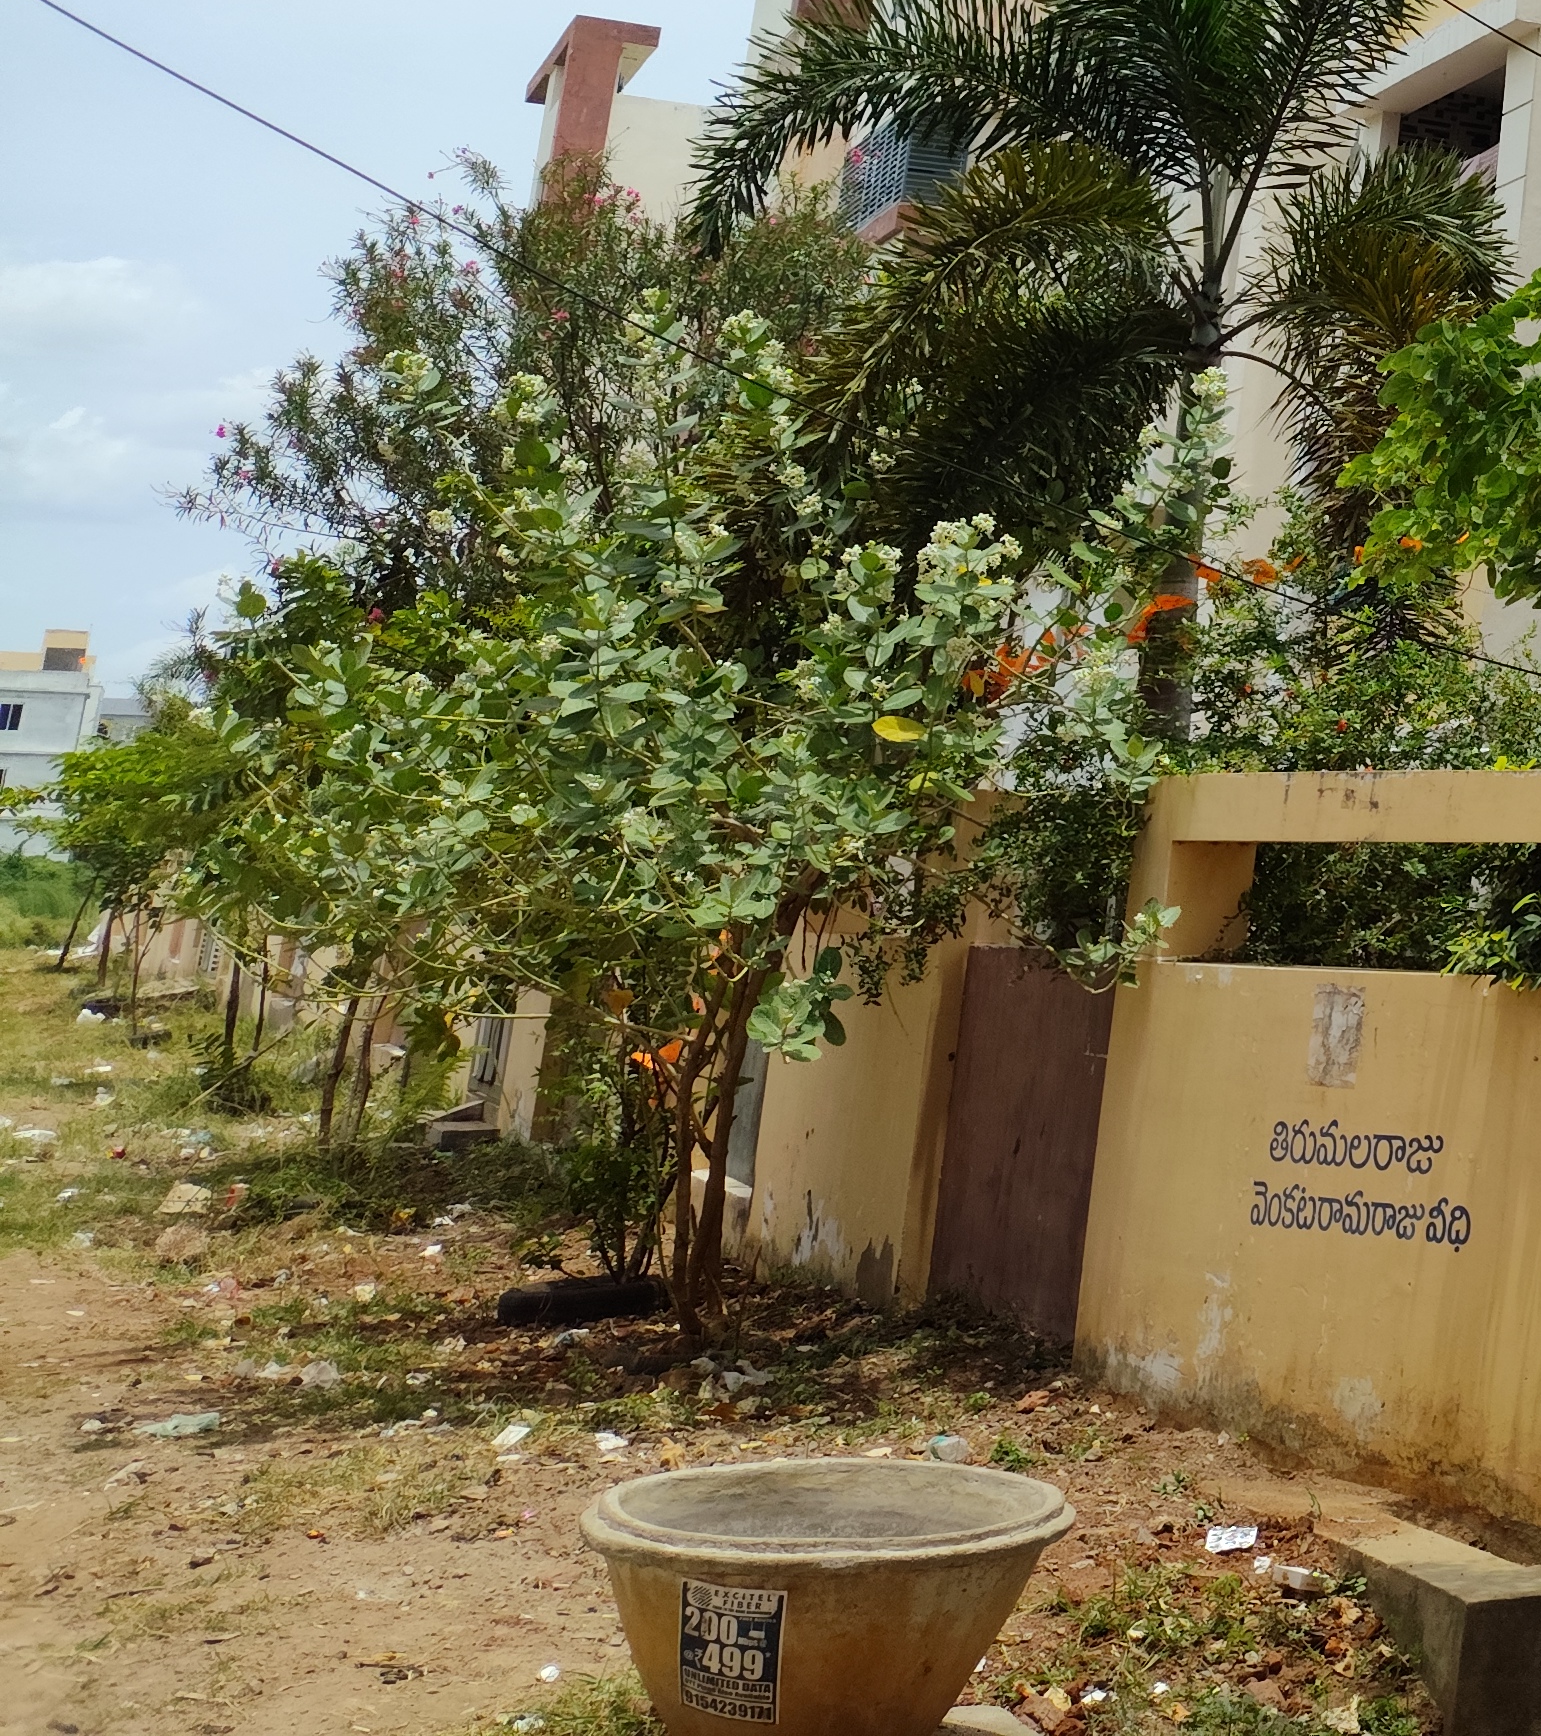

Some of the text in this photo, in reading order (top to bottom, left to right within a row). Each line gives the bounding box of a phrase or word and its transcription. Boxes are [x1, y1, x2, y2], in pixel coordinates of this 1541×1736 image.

[1270, 1119, 1444, 1174] తిరుమలరాజు
[1250, 1180, 1471, 1252] వెంకటరామరాజు వీధి
[723, 1600, 762, 1610] FIBER
[684, 1606, 738, 1644] 200
[684, 1667, 771, 1694] UNLIMITED DATA
